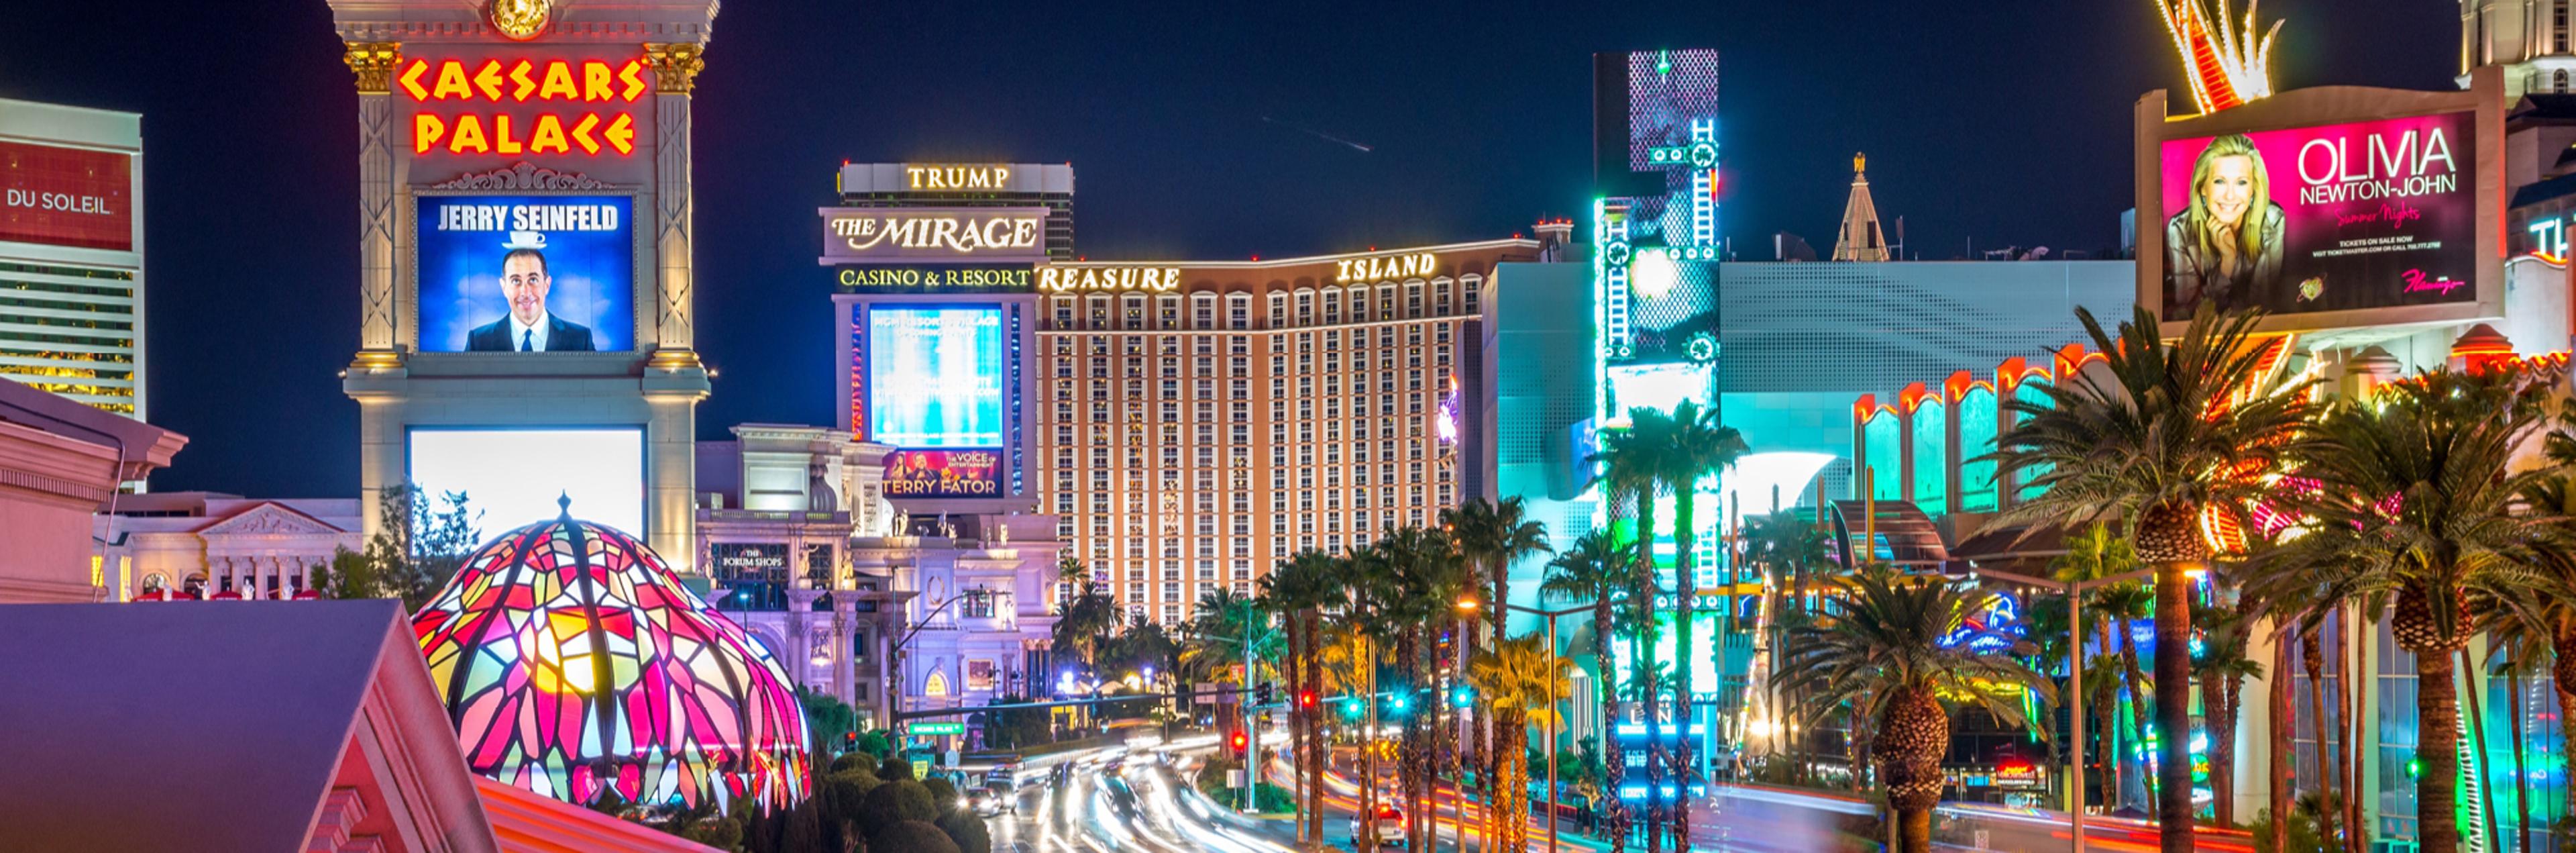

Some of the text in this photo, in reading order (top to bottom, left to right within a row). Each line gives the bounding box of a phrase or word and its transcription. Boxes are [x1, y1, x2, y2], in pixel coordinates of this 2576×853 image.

[399, 59, 647, 102] CAESARS
[416, 113, 633, 155] PALACE
[2298, 127, 2457, 185] OLIVIA
[907, 167, 1009, 189] TRUMP
[2300, 174, 2457, 206] NEWTON-JOHN
[7, 189, 36, 208] DU
[438, 205, 619, 231] JERRY SEINFELD
[2334, 200, 2421, 230] Summer Nights
[831, 217, 1038, 252] THE MIRAGE
[2339, 235, 2414, 248] TICKETS ON SALE NOW
[2312, 250, 2326, 258] VISIT
[2327, 246, 2382, 256] TICKETMASTER.COM
[839, 269, 1030, 287] CASINO & RESORT
[1033, 266, 1180, 291] REASURE
[1336, 252, 1436, 282] ISLAND
[2401, 268, 2465, 295] Flamingo
[957, 452, 988, 462] VOICE
[882, 479, 996, 494] TERRY FATOR
[723, 557, 782, 567] FORUM SHOPS
[746, 549, 759, 557] THE
